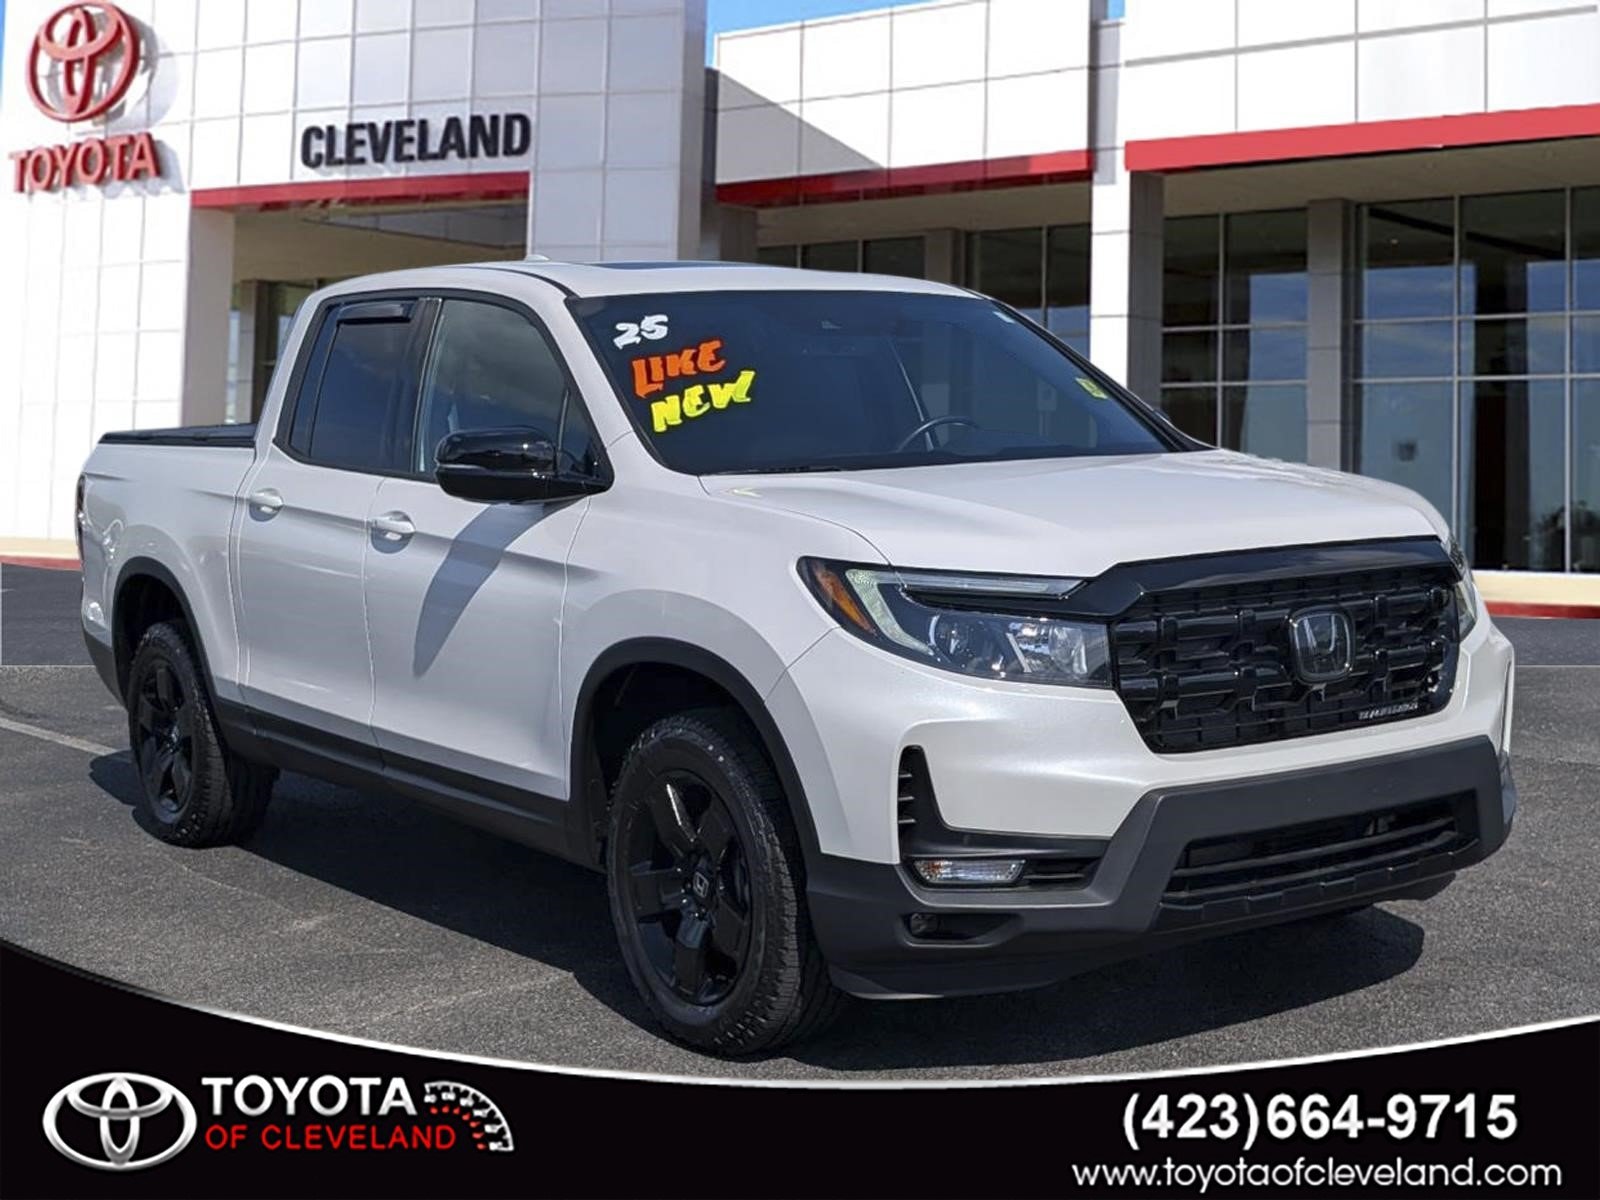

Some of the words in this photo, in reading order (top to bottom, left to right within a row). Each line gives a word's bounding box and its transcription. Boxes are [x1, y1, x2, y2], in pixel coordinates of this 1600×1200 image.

[9, 131, 162, 193] TOYOTA
[301, 113, 531, 169] CLEVELAND
[613, 314, 670, 350] 25
[631, 339, 726, 399] LIKE
[651, 370, 755, 433] NEW
